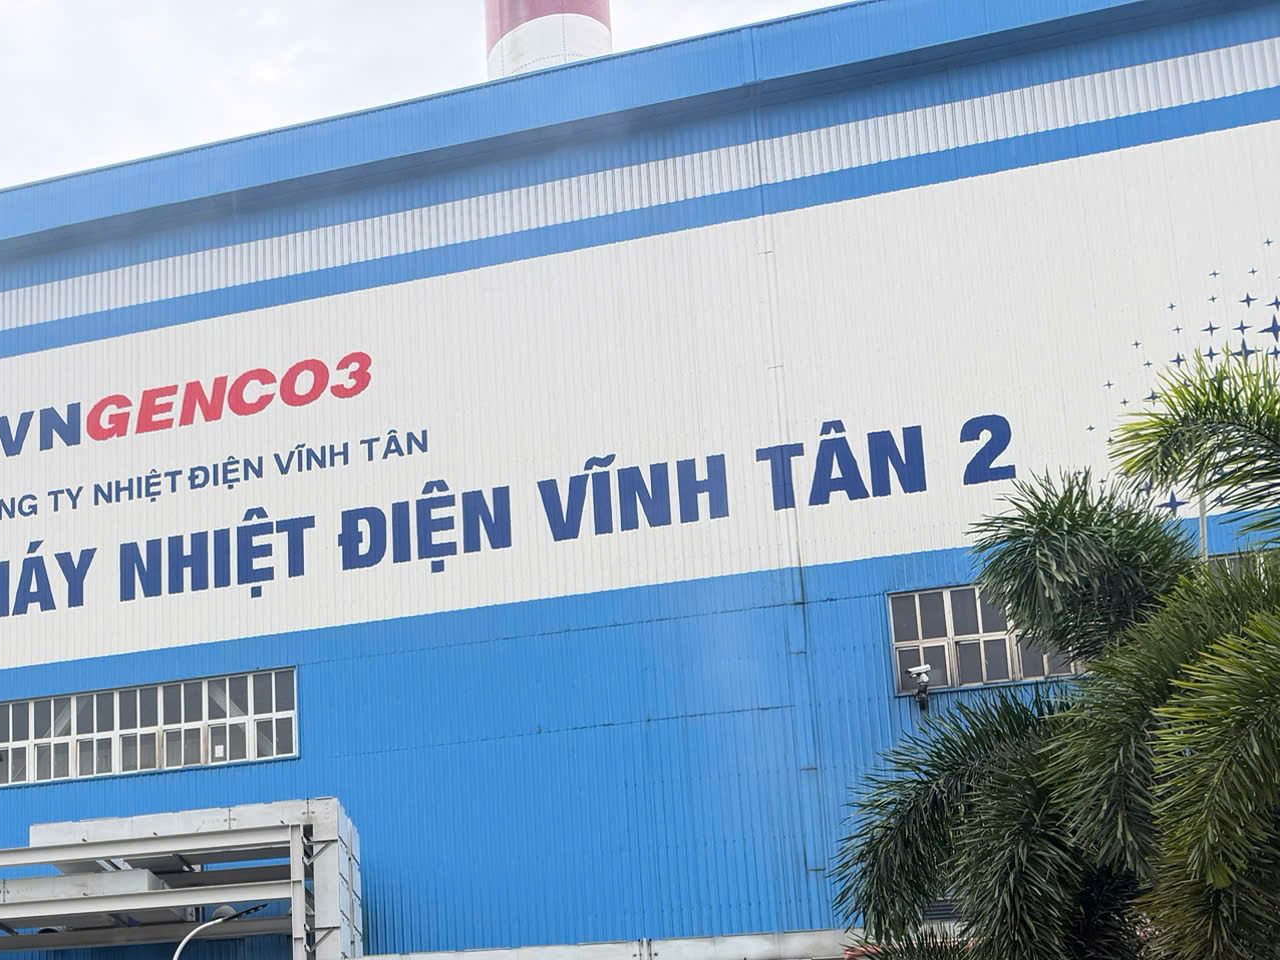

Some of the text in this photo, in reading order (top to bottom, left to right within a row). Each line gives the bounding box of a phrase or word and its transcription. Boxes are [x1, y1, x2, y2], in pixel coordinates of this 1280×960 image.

[48, 487, 84, 513] TY
[94, 469, 183, 505] NHIỆT
[188, 456, 263, 489] ĐIỆN
[274, 436, 349, 472] VĨNH
[360, 429, 428, 460] TÂN
[119, 507, 315, 602] NHIỆT
[337, 480, 511, 573] ĐIỆN
[537, 453, 729, 542] VĨNH
[755, 420, 926, 511] TÂN
[958, 414, 1016, 485] 2
